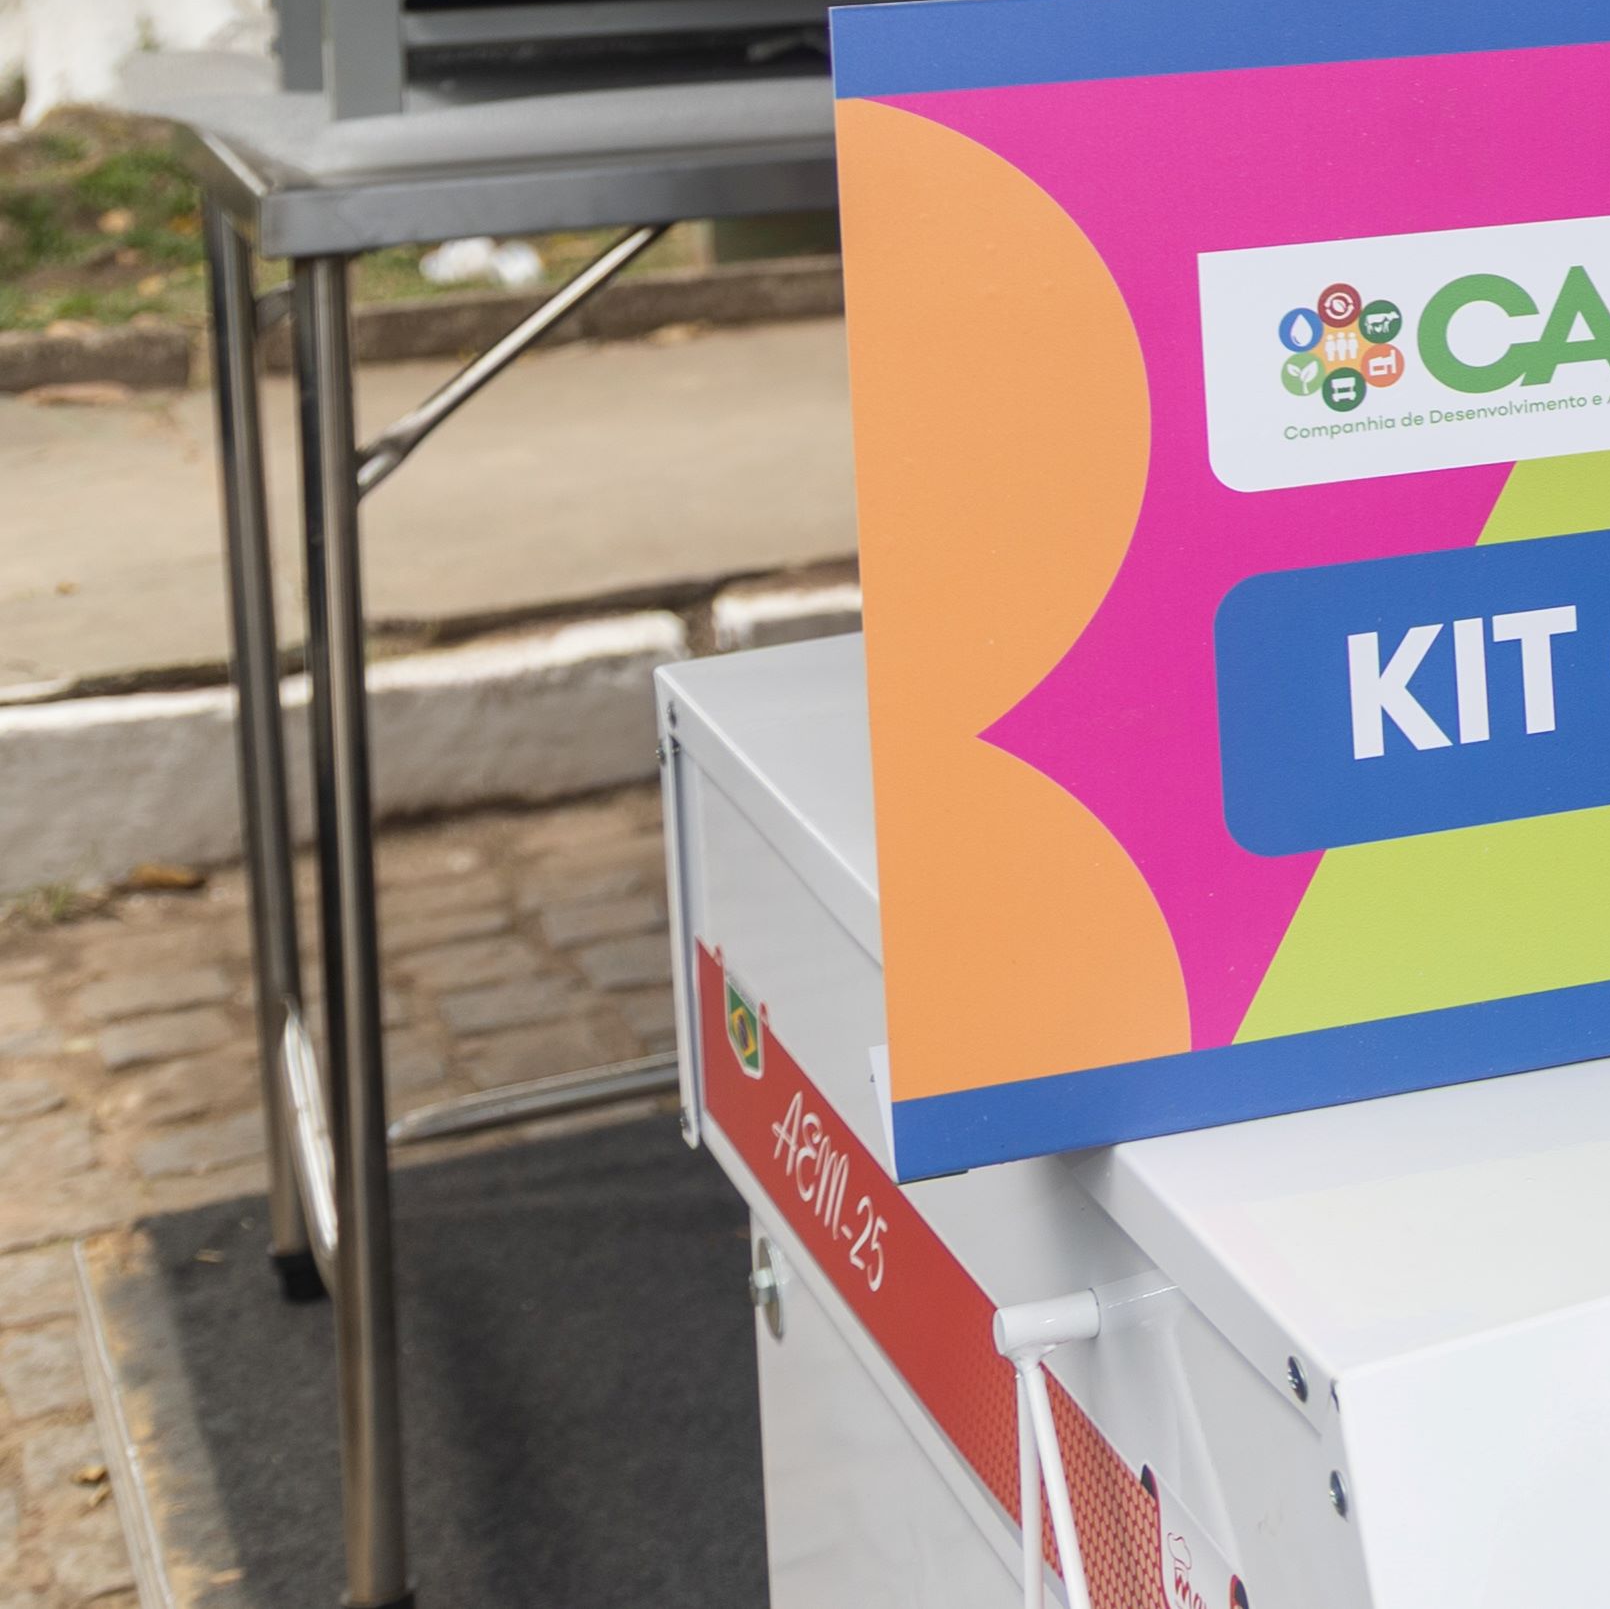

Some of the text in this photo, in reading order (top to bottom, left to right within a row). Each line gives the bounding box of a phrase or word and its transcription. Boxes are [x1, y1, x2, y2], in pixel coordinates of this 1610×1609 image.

[1283, 412, 1396, 441] Companhia
[1400, 408, 1424, 427] de
[1429, 390, 1588, 425] Desenvolvimento
[1592, 395, 1604, 407] e
[1347, 603, 1578, 761] KIT
[771, 1090, 888, 1293] AEM-25
